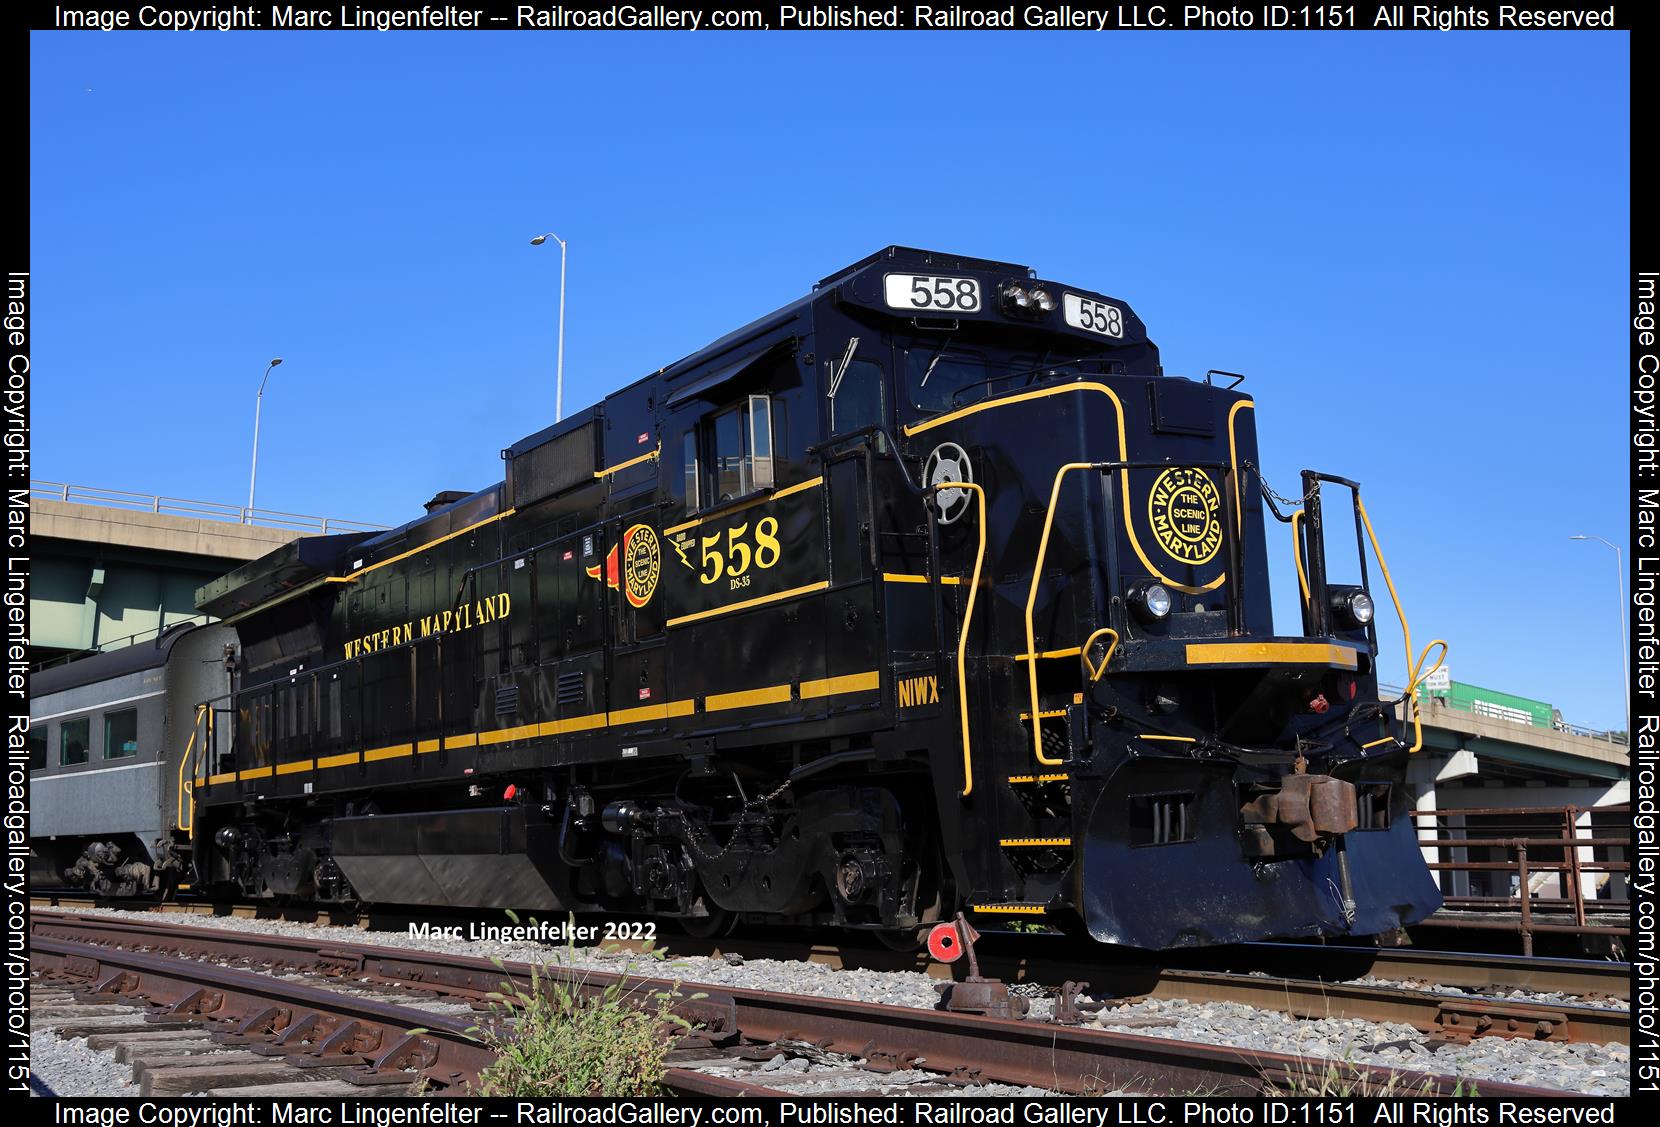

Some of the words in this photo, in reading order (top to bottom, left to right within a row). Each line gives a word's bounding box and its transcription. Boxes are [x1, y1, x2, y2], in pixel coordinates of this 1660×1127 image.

[910, 277, 978, 310] 558
[1080, 301, 1122, 337] 558
[1154, 470, 1219, 512] WESTERN
[1180, 494, 1198, 504] THE
[1173, 509, 1206, 520] SCENIC
[1181, 524, 1201, 534] LINE
[627, 529, 658, 561] WESTERN
[638, 547, 647, 556] THE
[700, 517, 781, 585] 558
[1154, 515, 1220, 559] MARYLAND
[627, 561, 658, 596] MARYLAND
[730, 575, 751, 590] DS-35
[344, 622, 413, 660] WESTERN
[420, 592, 511, 638] MARYLAND
[898, 675, 939, 708] NIWX
